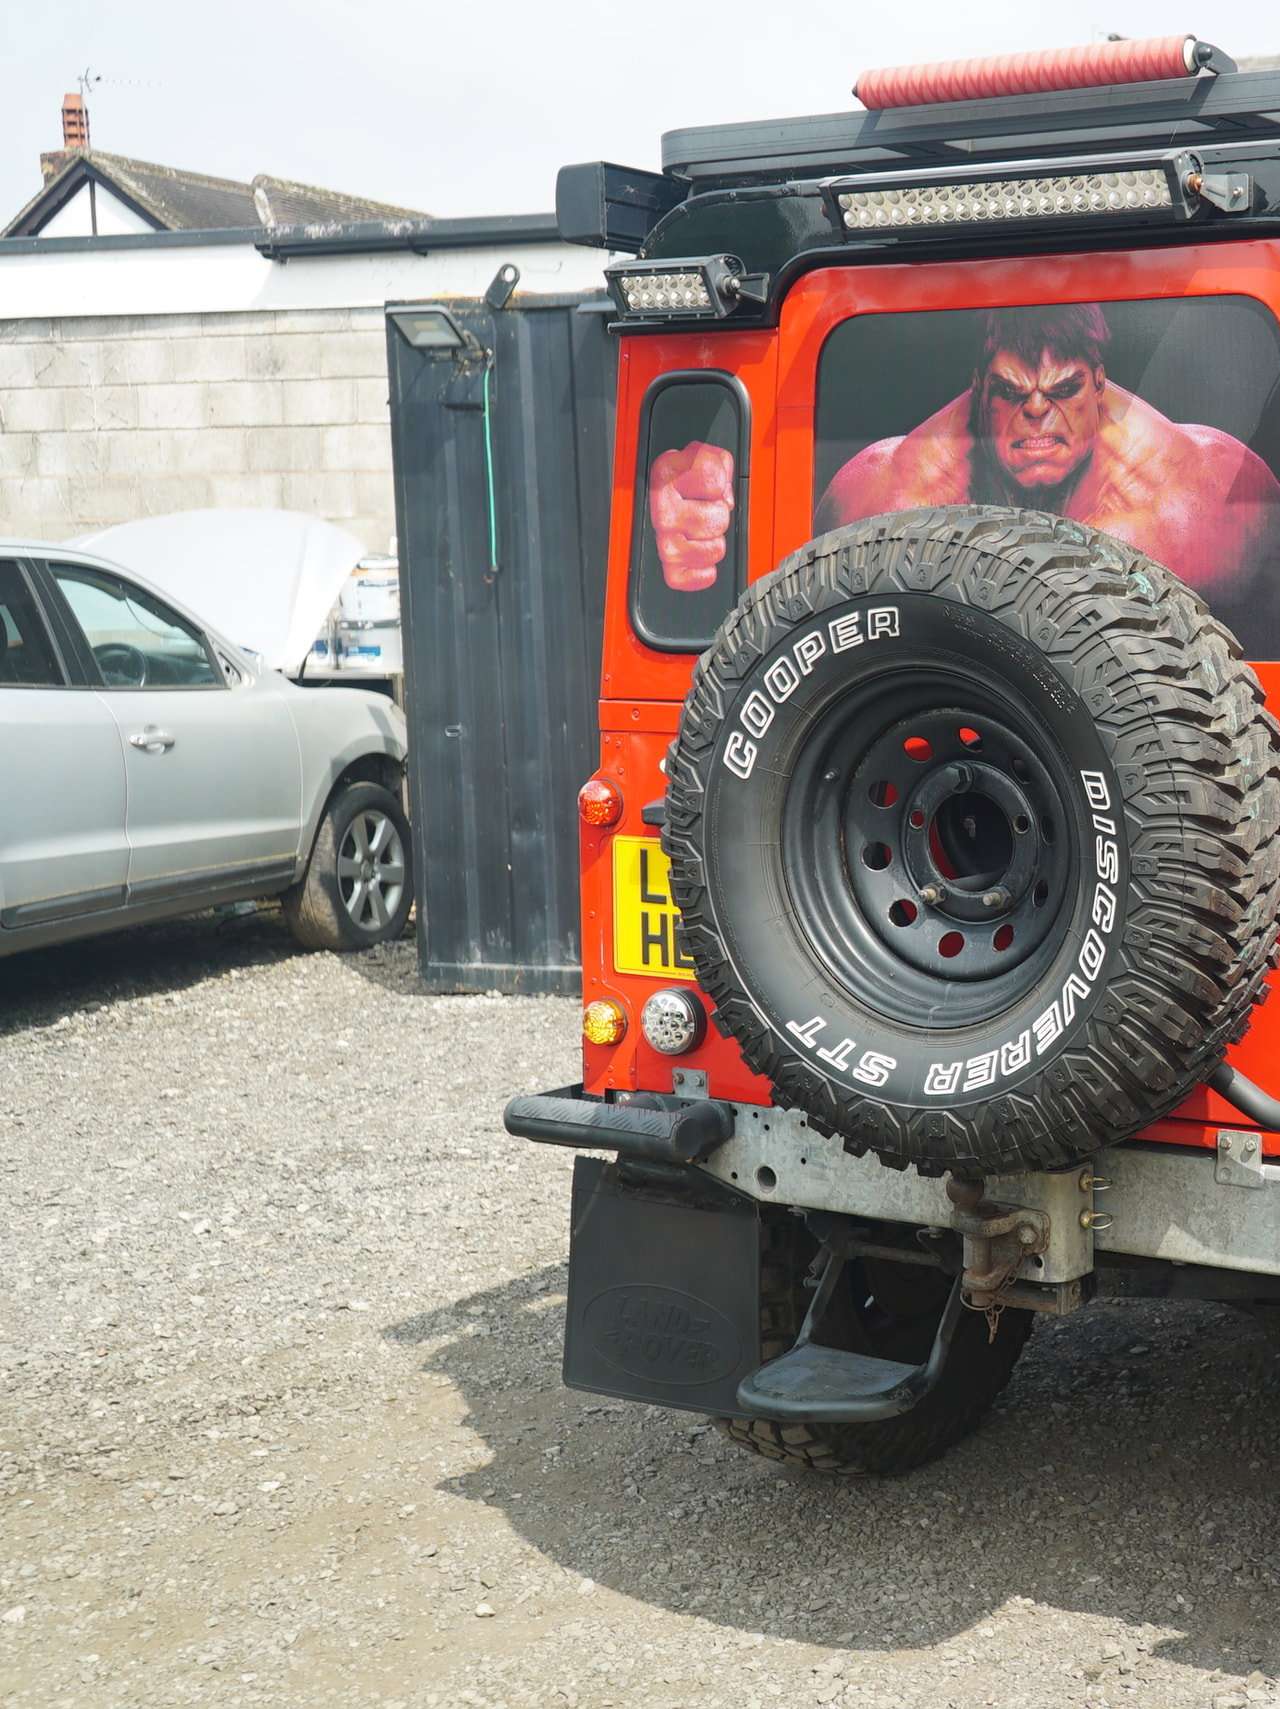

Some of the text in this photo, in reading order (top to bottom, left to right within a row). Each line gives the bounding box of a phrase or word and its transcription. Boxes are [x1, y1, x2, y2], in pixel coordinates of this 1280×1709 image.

[722, 605, 901, 780] COOPER
[785, 769, 1119, 1096] DISCOVERER STT
